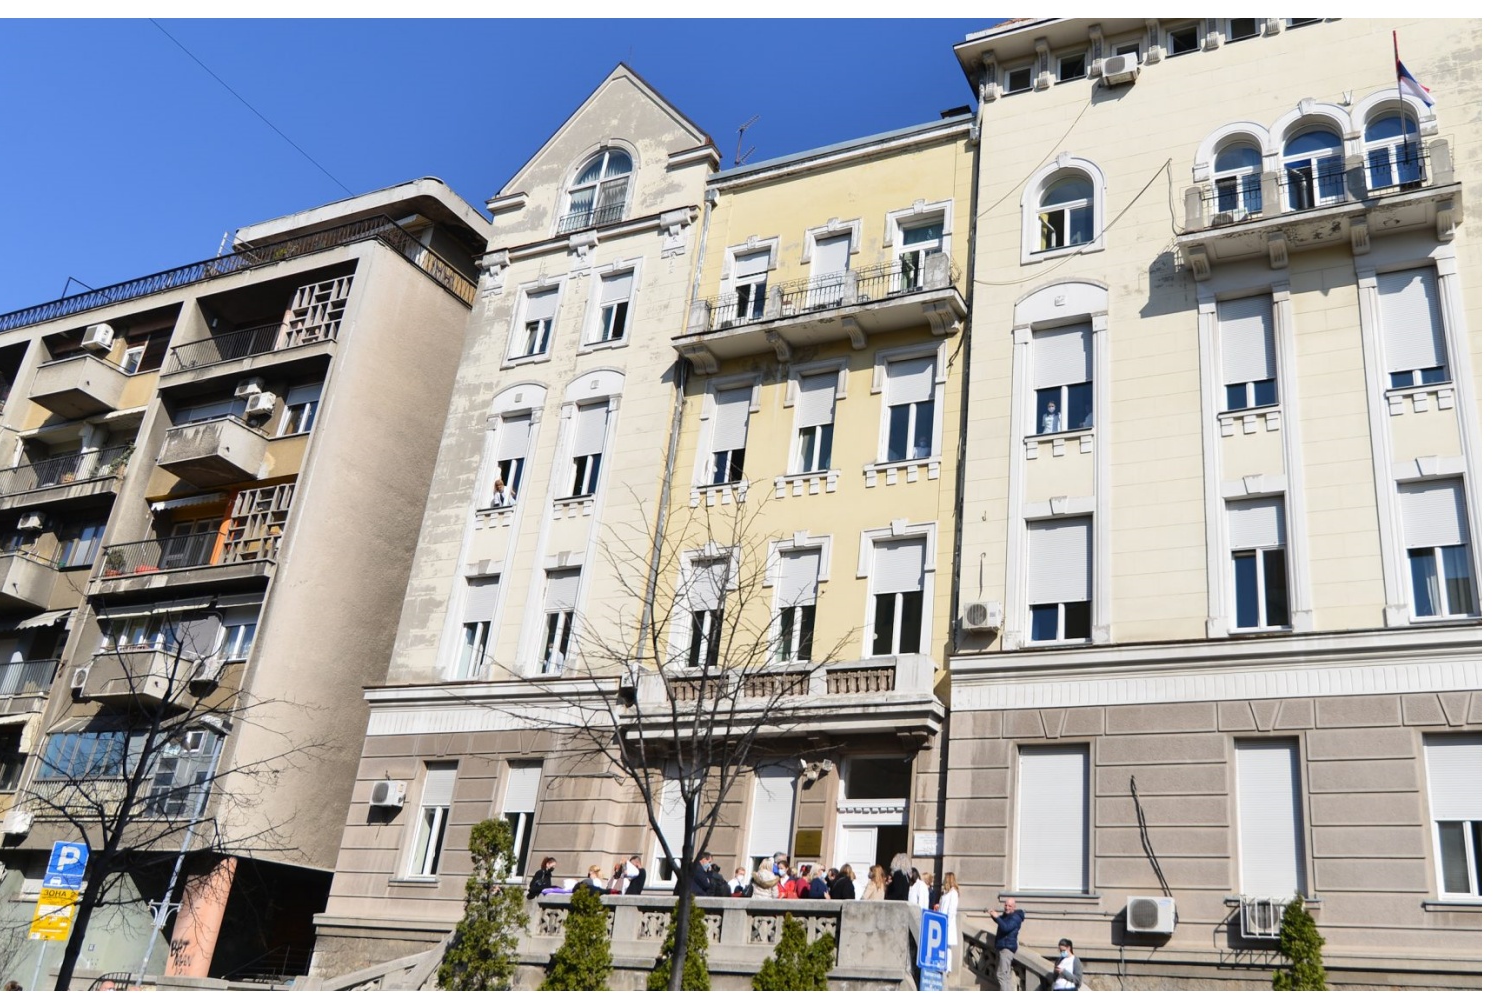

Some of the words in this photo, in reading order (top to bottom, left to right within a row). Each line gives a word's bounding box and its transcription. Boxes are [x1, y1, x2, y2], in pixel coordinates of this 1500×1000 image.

[57, 846, 81, 871] P
[43, 889, 67, 898] ЗОНА
[70, 891, 77, 899] 2
[925, 919, 942, 966] P
